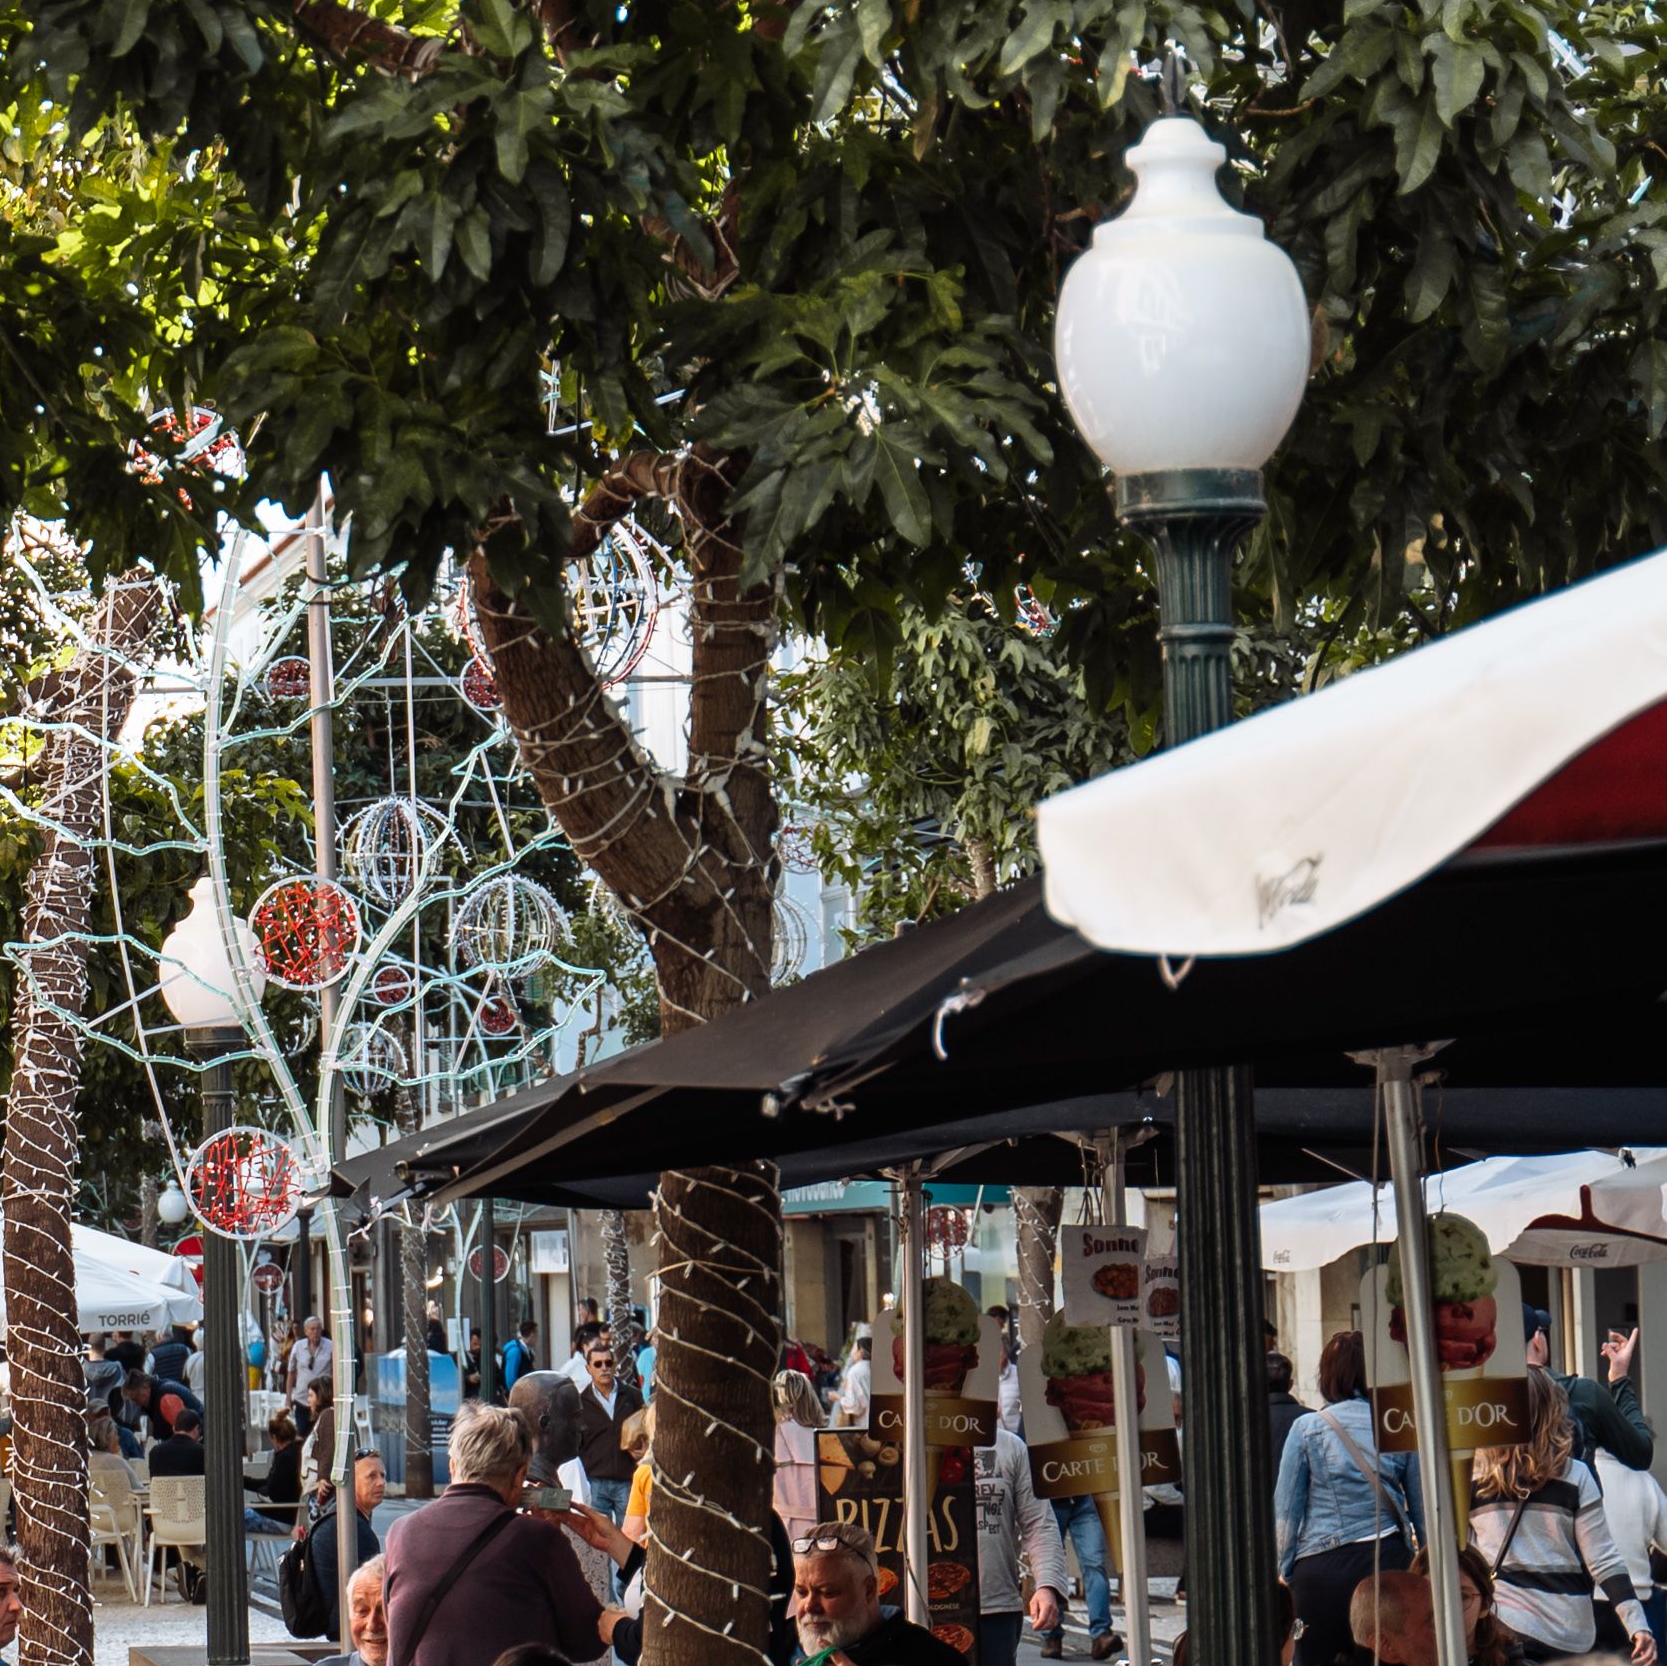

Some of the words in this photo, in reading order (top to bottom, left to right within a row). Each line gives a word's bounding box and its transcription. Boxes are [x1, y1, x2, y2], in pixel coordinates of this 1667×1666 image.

[939, 1414, 986, 1435] D'OR
[1457, 1402, 1518, 1428] D'OR
[1042, 1457, 1106, 1483] CARTE
